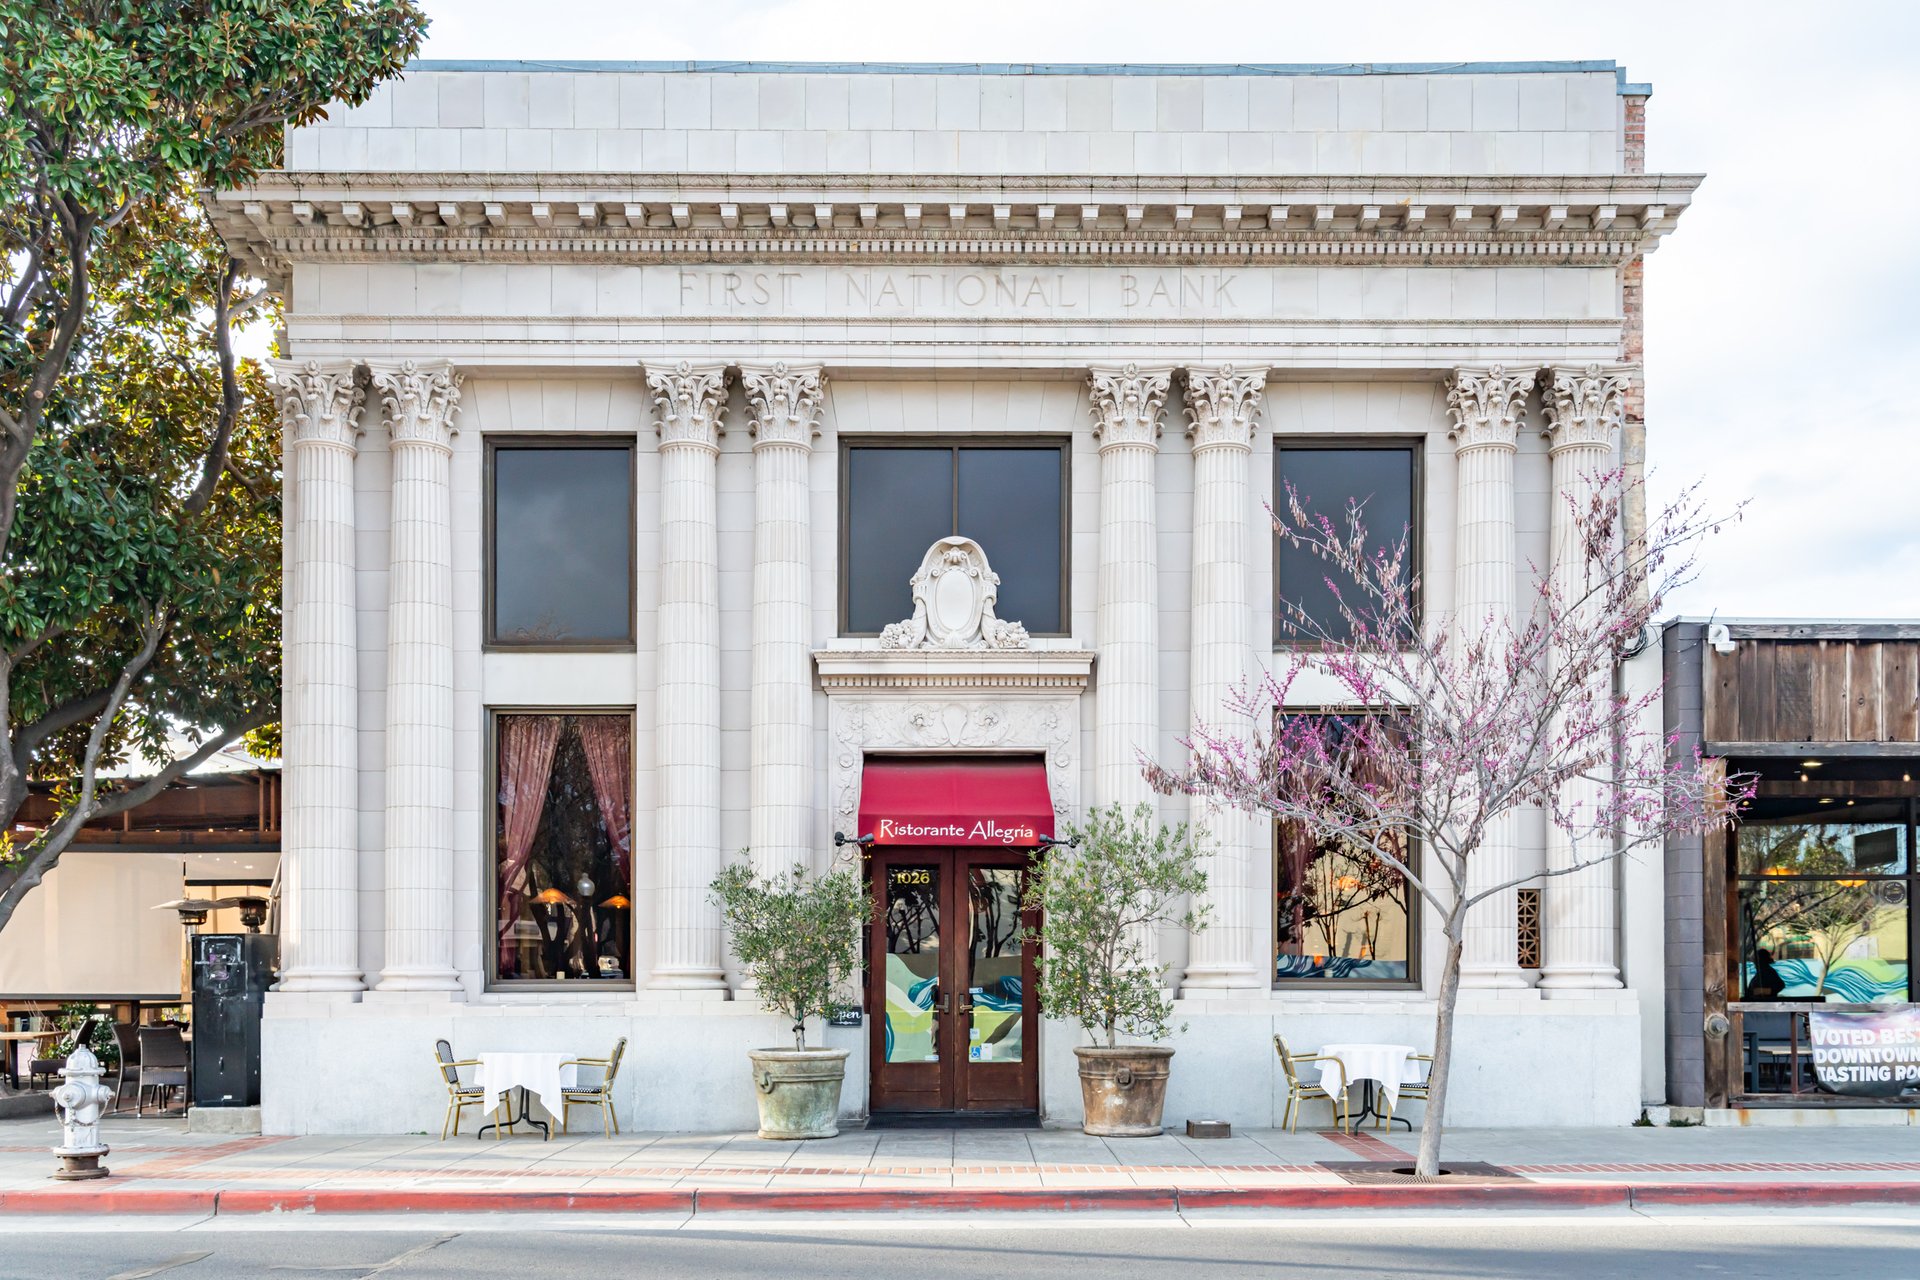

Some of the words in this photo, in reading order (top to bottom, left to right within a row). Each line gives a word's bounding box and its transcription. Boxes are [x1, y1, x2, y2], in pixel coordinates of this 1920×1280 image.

[679, 272, 802, 306] FIRST
[845, 273, 1077, 308] NATIONAL
[1119, 274, 1238, 308] BANK
[880, 819, 965, 838] Ristorante
[968, 820, 1034, 844] Allegria
[896, 871, 930, 885] 1026
[1813, 1029, 1876, 1046] VOTED
[1814, 1047, 1920, 1064] DOWNTOWN
[1817, 1065, 1891, 1082] TASTING
[1895, 1064, 1920, 1081] RO
